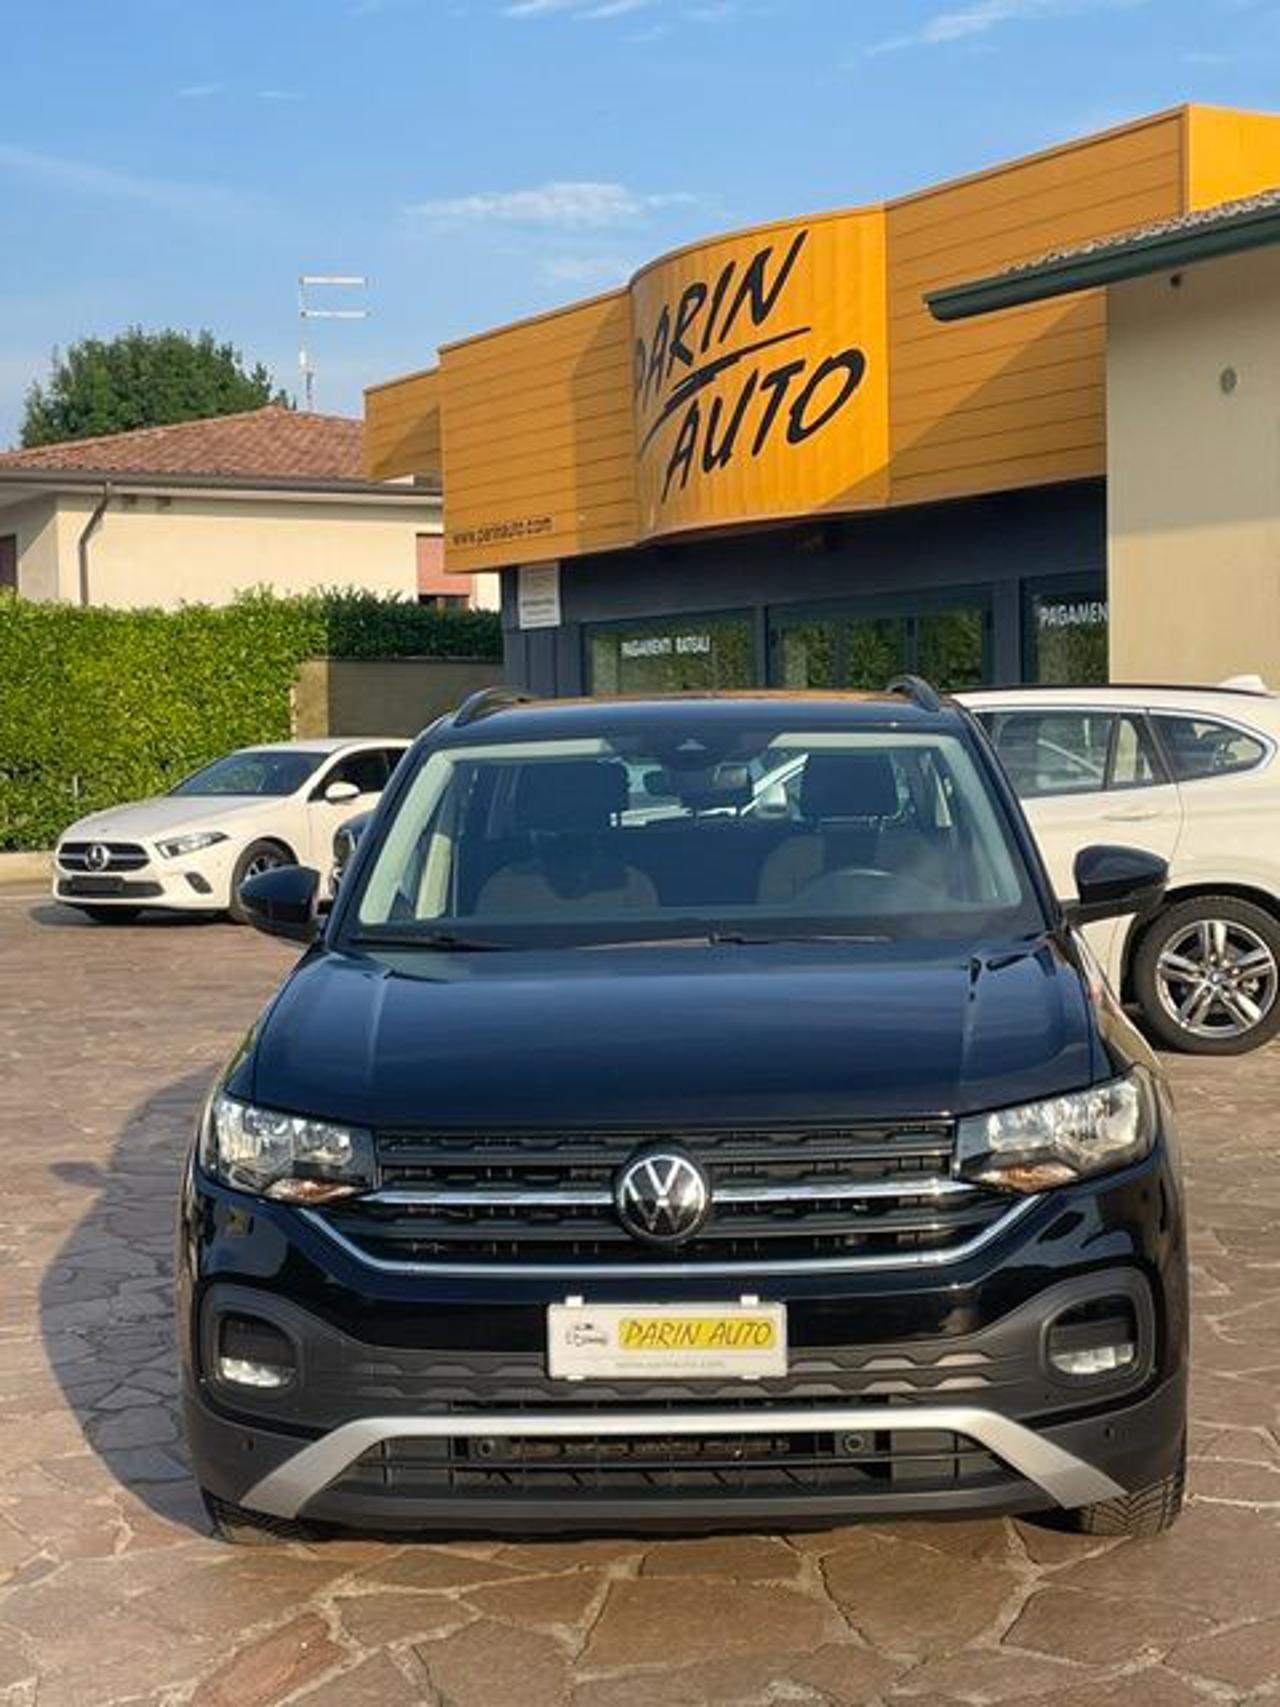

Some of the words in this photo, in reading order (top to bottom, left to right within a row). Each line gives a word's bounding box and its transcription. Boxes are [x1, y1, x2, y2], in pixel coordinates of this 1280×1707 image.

[635, 229, 808, 411] PARIN
[661, 348, 865, 504] AUTO
[624, 1320, 701, 1347] PARIN
[709, 1320, 772, 1347] AUTO
